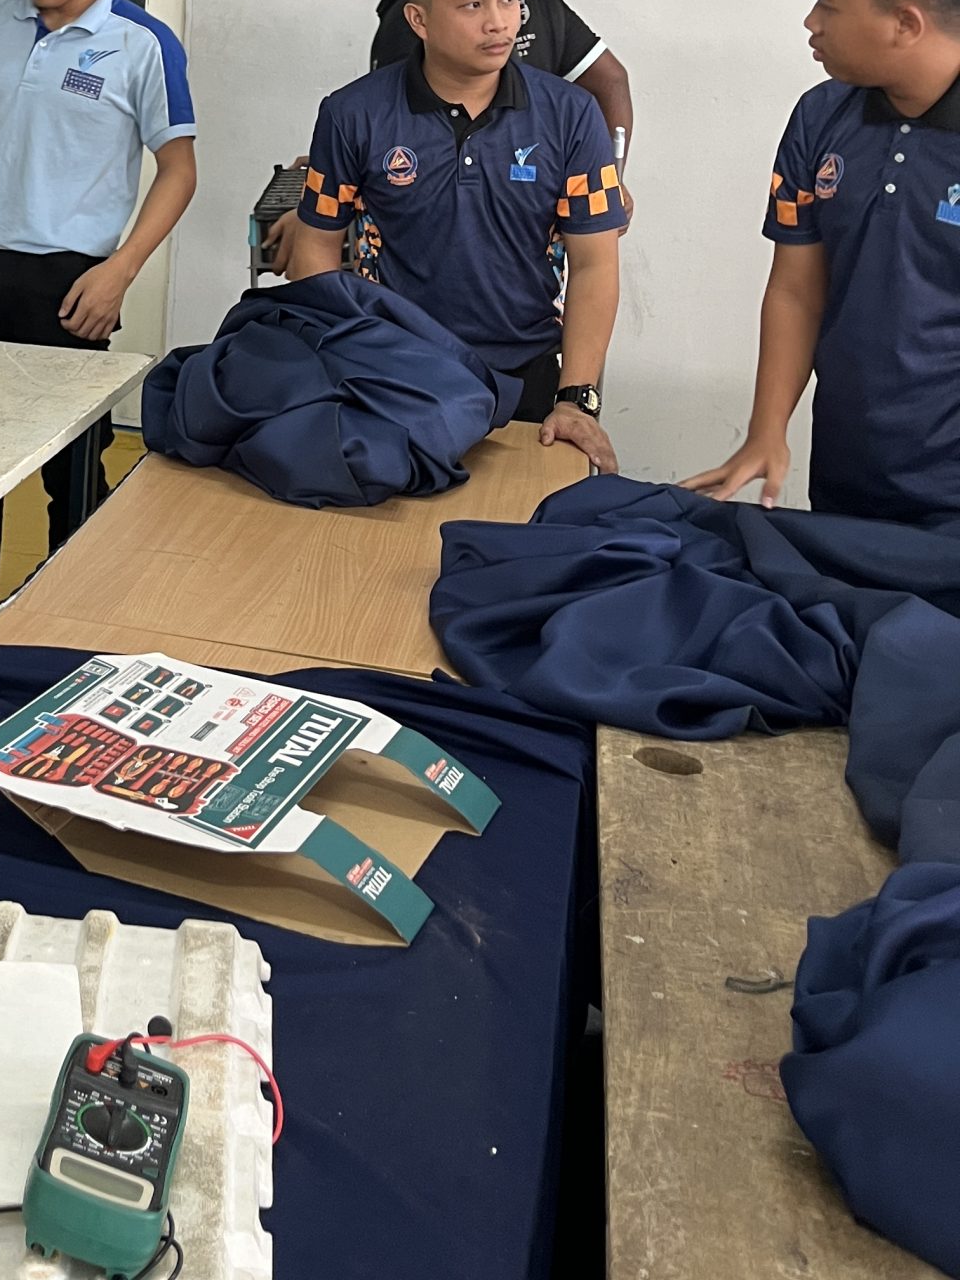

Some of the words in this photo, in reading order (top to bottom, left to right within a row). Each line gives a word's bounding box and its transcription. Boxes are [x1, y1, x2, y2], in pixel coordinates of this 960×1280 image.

[267, 713, 342, 767] TOTAL
[438, 766, 464, 795] TOTAL
[242, 789, 264, 804] Tools
[222, 802, 249, 824] Station
[362, 865, 392, 901] TOTAL
